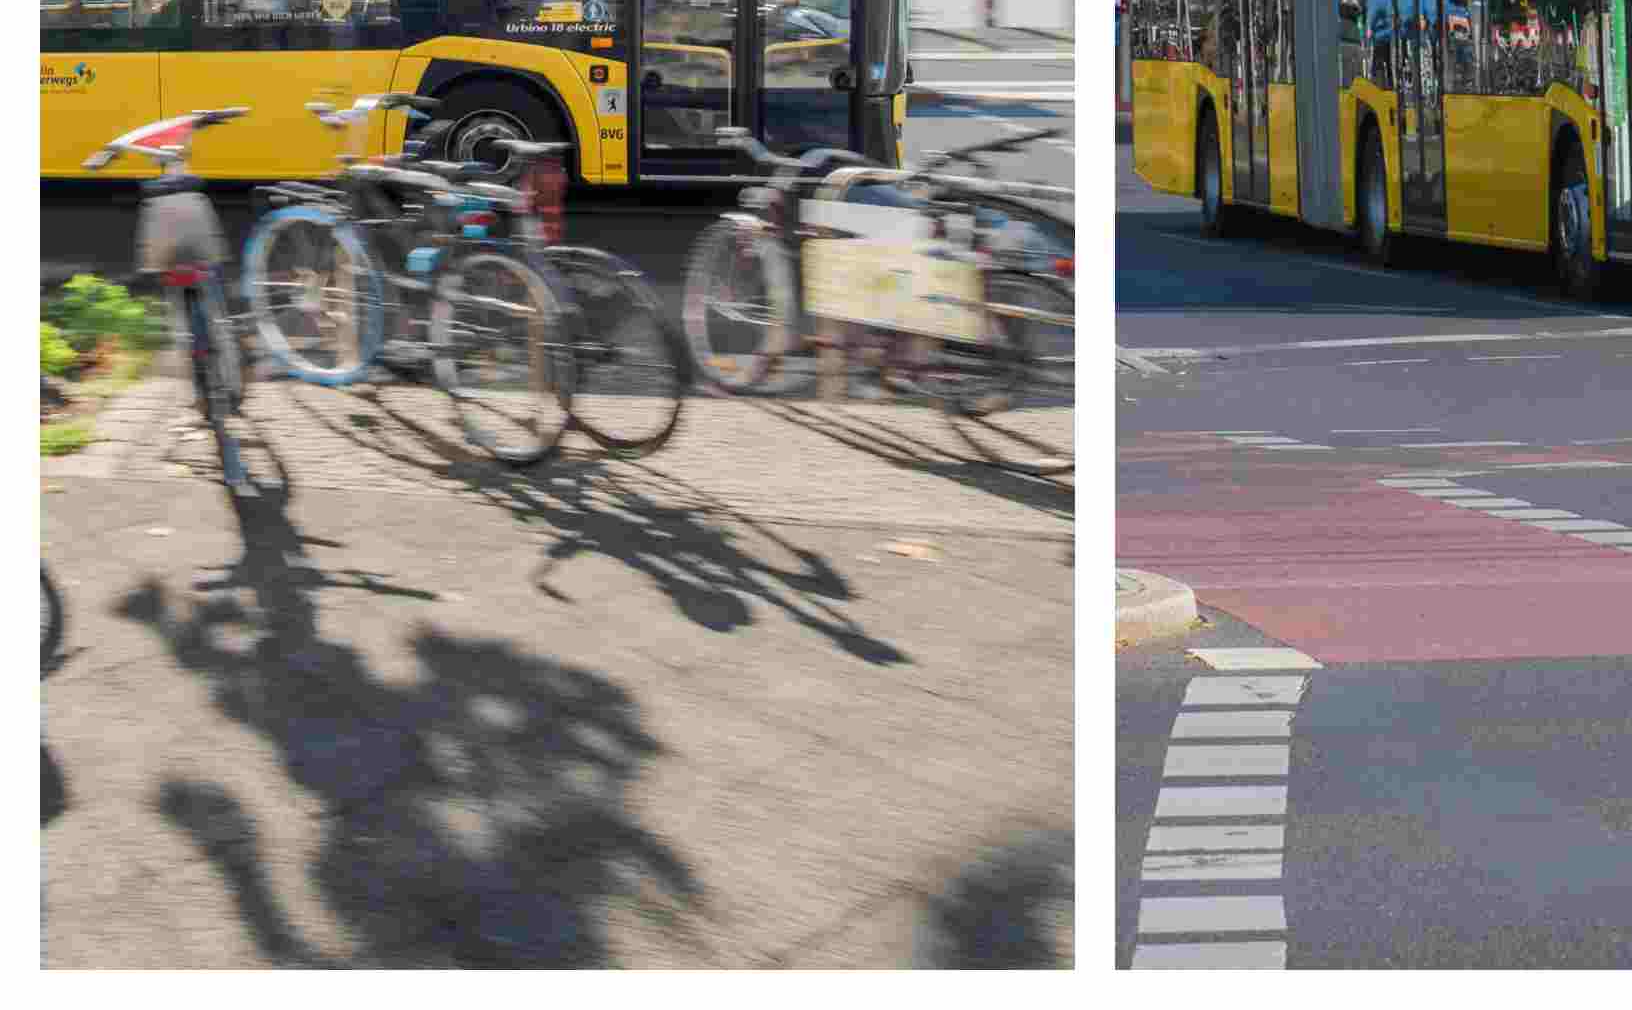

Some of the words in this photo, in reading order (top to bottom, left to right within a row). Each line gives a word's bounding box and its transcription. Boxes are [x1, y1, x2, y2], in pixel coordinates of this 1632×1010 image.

[506, 22, 548, 33] Urbino
[567, 22, 617, 32] electric
[600, 128, 624, 141] BVG
